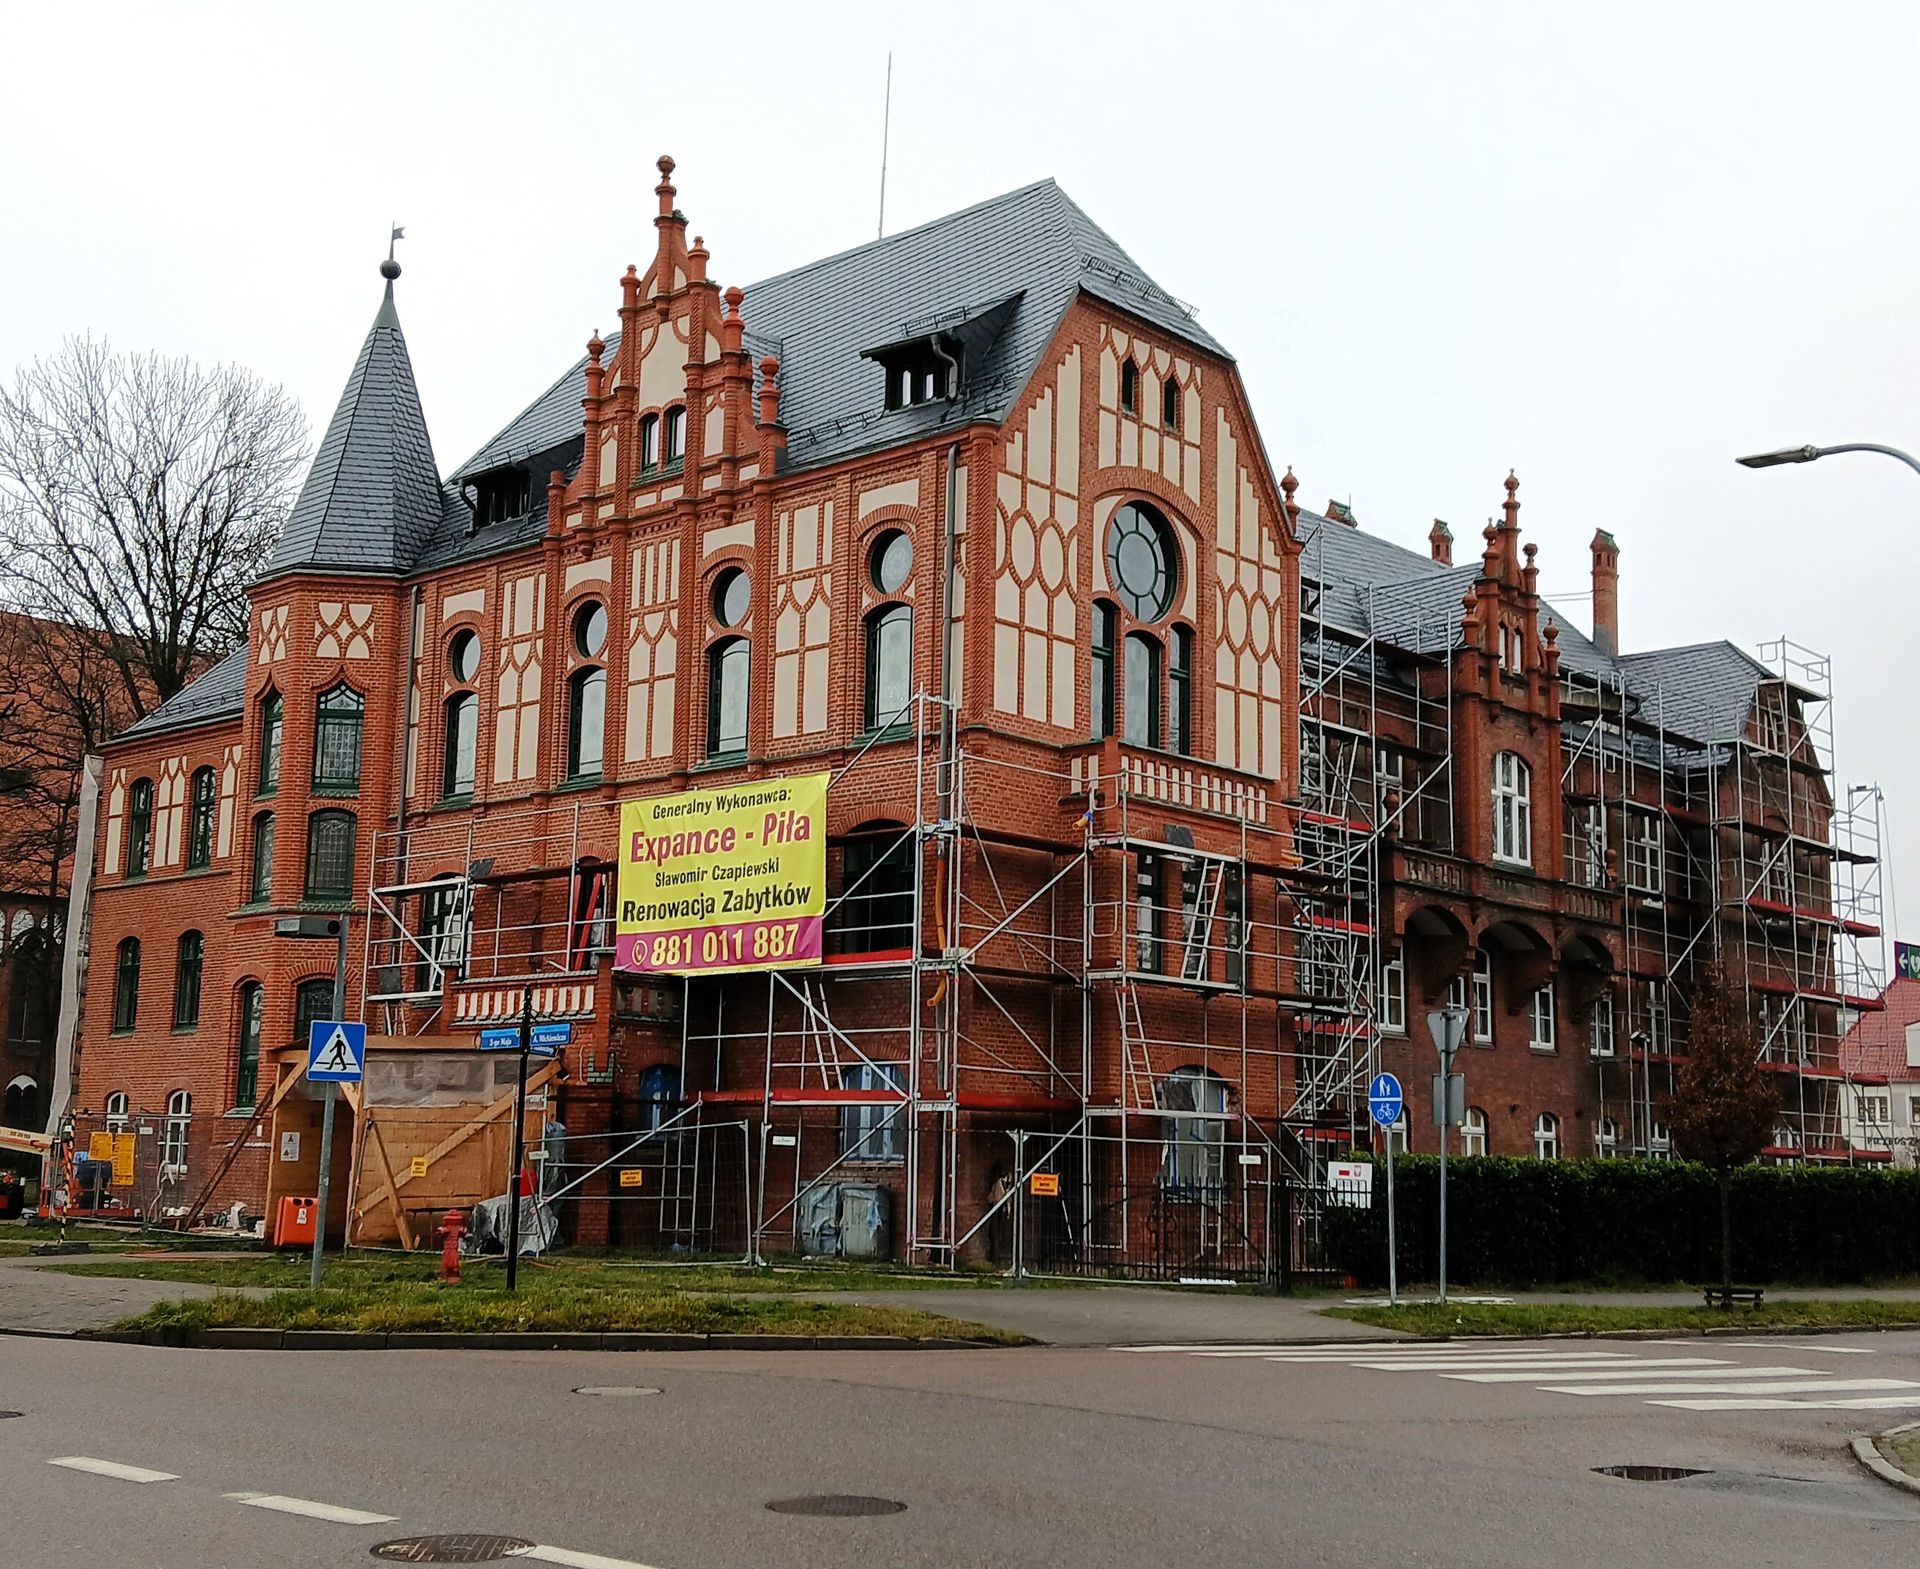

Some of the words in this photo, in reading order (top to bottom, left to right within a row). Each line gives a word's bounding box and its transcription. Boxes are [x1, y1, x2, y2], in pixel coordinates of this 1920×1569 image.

[652, 798, 712, 820] Generalny
[716, 788, 792, 813] Wykonawca:
[630, 825, 736, 867] Expance
[762, 809, 811, 847] Piła
[655, 866, 708, 888] Sławomir
[711, 857, 780, 882] Czapiewski
[622, 892, 716, 923] Renowacja
[721, 882, 811, 914] Zabytków
[650, 933, 693, 966] 881
[702, 929, 743, 963] 011
[753, 923, 800, 959] 887
